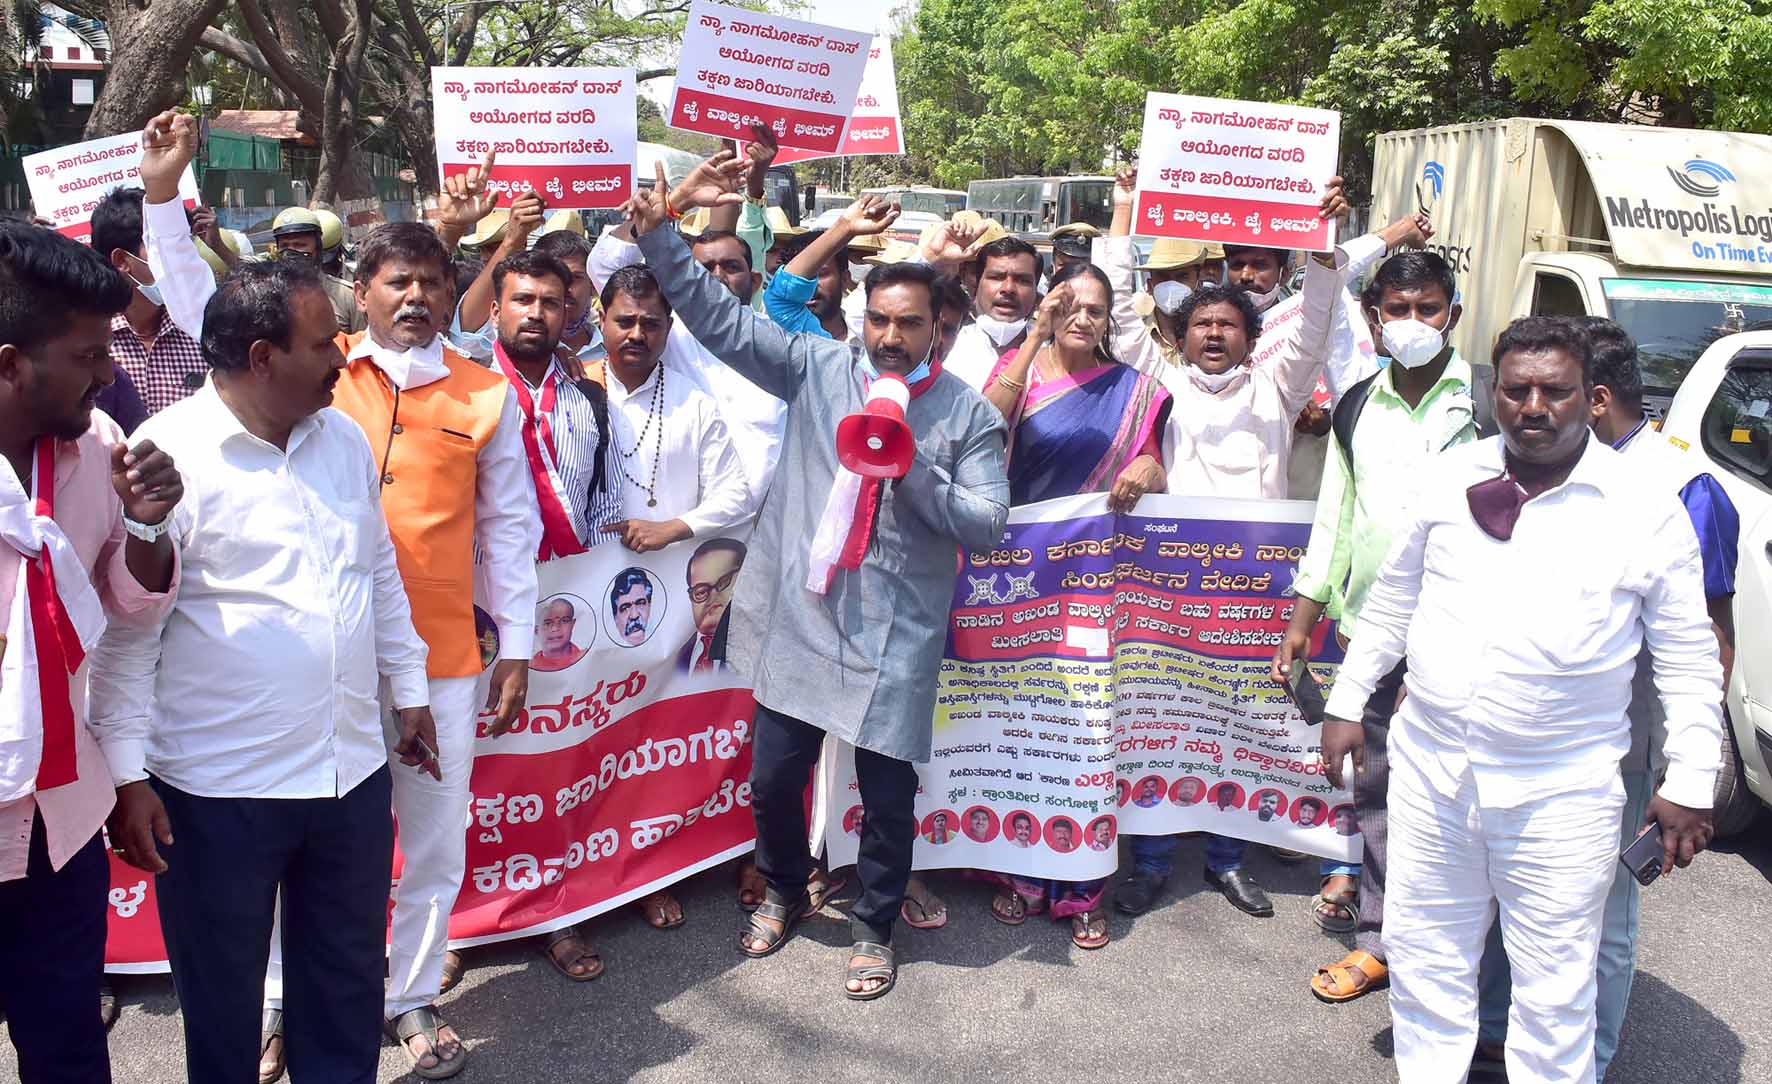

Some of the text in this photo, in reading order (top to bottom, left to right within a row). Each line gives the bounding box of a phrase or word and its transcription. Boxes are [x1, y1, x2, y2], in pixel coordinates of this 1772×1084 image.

[730, 20, 823, 48] ನಾಗಮೋಹನ್
[826, 37, 860, 55] ದಾಸ್
[719, 46, 830, 77] ಆಯೋಗದ ವರದಿ
[474, 79, 578, 94] ನಾಗಮೋಹನ್
[583, 80, 622, 95] ದಾಸ್
[698, 70, 730, 90] ತಕ್ಷಣ
[734, 73, 837, 105] ಜಾರಿಯಾಗಬೇಕು.
[470, 109, 595, 124] ಆಯೋಗದ ವರದಿ
[682, 101, 698, 122] ಜೈ
[772, 118, 787, 137] ಜೈ
[794, 121, 836, 138] ಭೀಮ್
[1191, 110, 1293, 132] ನಾಗಮೋಹನ್
[57, 142, 138, 170] ನಾಗಮೋಹನ್
[456, 138, 614, 160] ತಕ್ಷಣ ಜಾರಿಯಾಗಬೇಕು.
[1181, 139, 1305, 163] ಆಯೋಗದ ವರದಿ
[58, 171, 124, 194] ಆಯೋಗದ
[545, 177, 564, 199] ಜೈ
[572, 176, 621, 194] ಭೀಮ್
[1160, 167, 1317, 195] ತಕ್ಷಣ ಜಾರಿಯಾಗಬೇಕು.
[53, 205, 80, 222] ತಕ್ಷಣ
[1147, 203, 1165, 226] ಜೈ
[1245, 212, 1263, 234] ಜೈ
[1270, 217, 1319, 233] ಭೀಮ್
[1605, 196, 1732, 237] Metropolis
[1692, 241, 1715, 259] On
[1716, 242, 1755, 262] Time
[1158, 541, 1244, 567] ವಾಲ್ಮೀಕಿ
[1200, 571, 1272, 592] ವೇದಿಕೆ
[956, 611, 1004, 628] ನಾಡಿನ
[1012, 600, 1059, 624] ಅಖಂಡ
[1180, 603, 1211, 619] ಬಹು
[1218, 604, 1275, 621] ವರ್ಷಗಳ
[1136, 616, 1192, 637] ಸರ್ಕಾರ
[1184, 738, 1223, 763] ನಮ್ಮ
